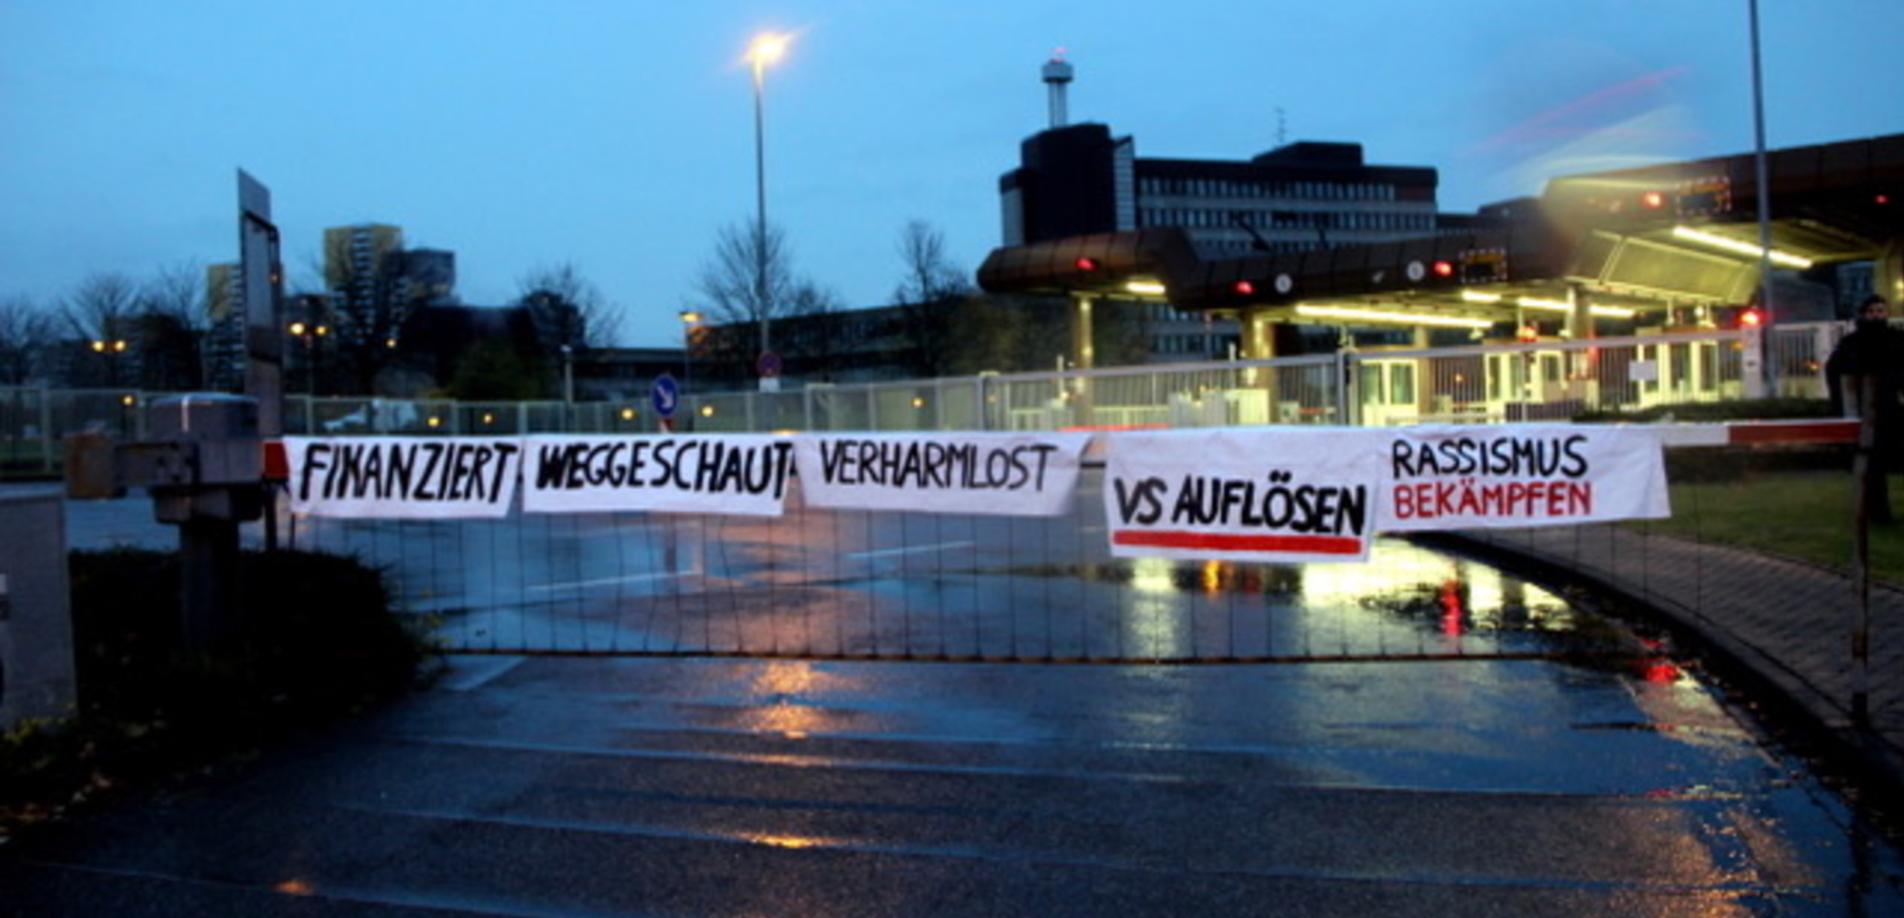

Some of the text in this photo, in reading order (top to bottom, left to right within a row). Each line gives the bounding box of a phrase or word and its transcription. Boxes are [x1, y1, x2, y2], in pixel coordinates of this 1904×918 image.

[536, 439, 793, 499] WEGGESCHAUT
[820, 439, 1057, 492] VERHARMLOST
[1392, 435, 1588, 478] RASSISMUS
[1114, 470, 1366, 536] VS AUFLÖSEN
[1393, 479, 1592, 519] BEKÄMPFEN
